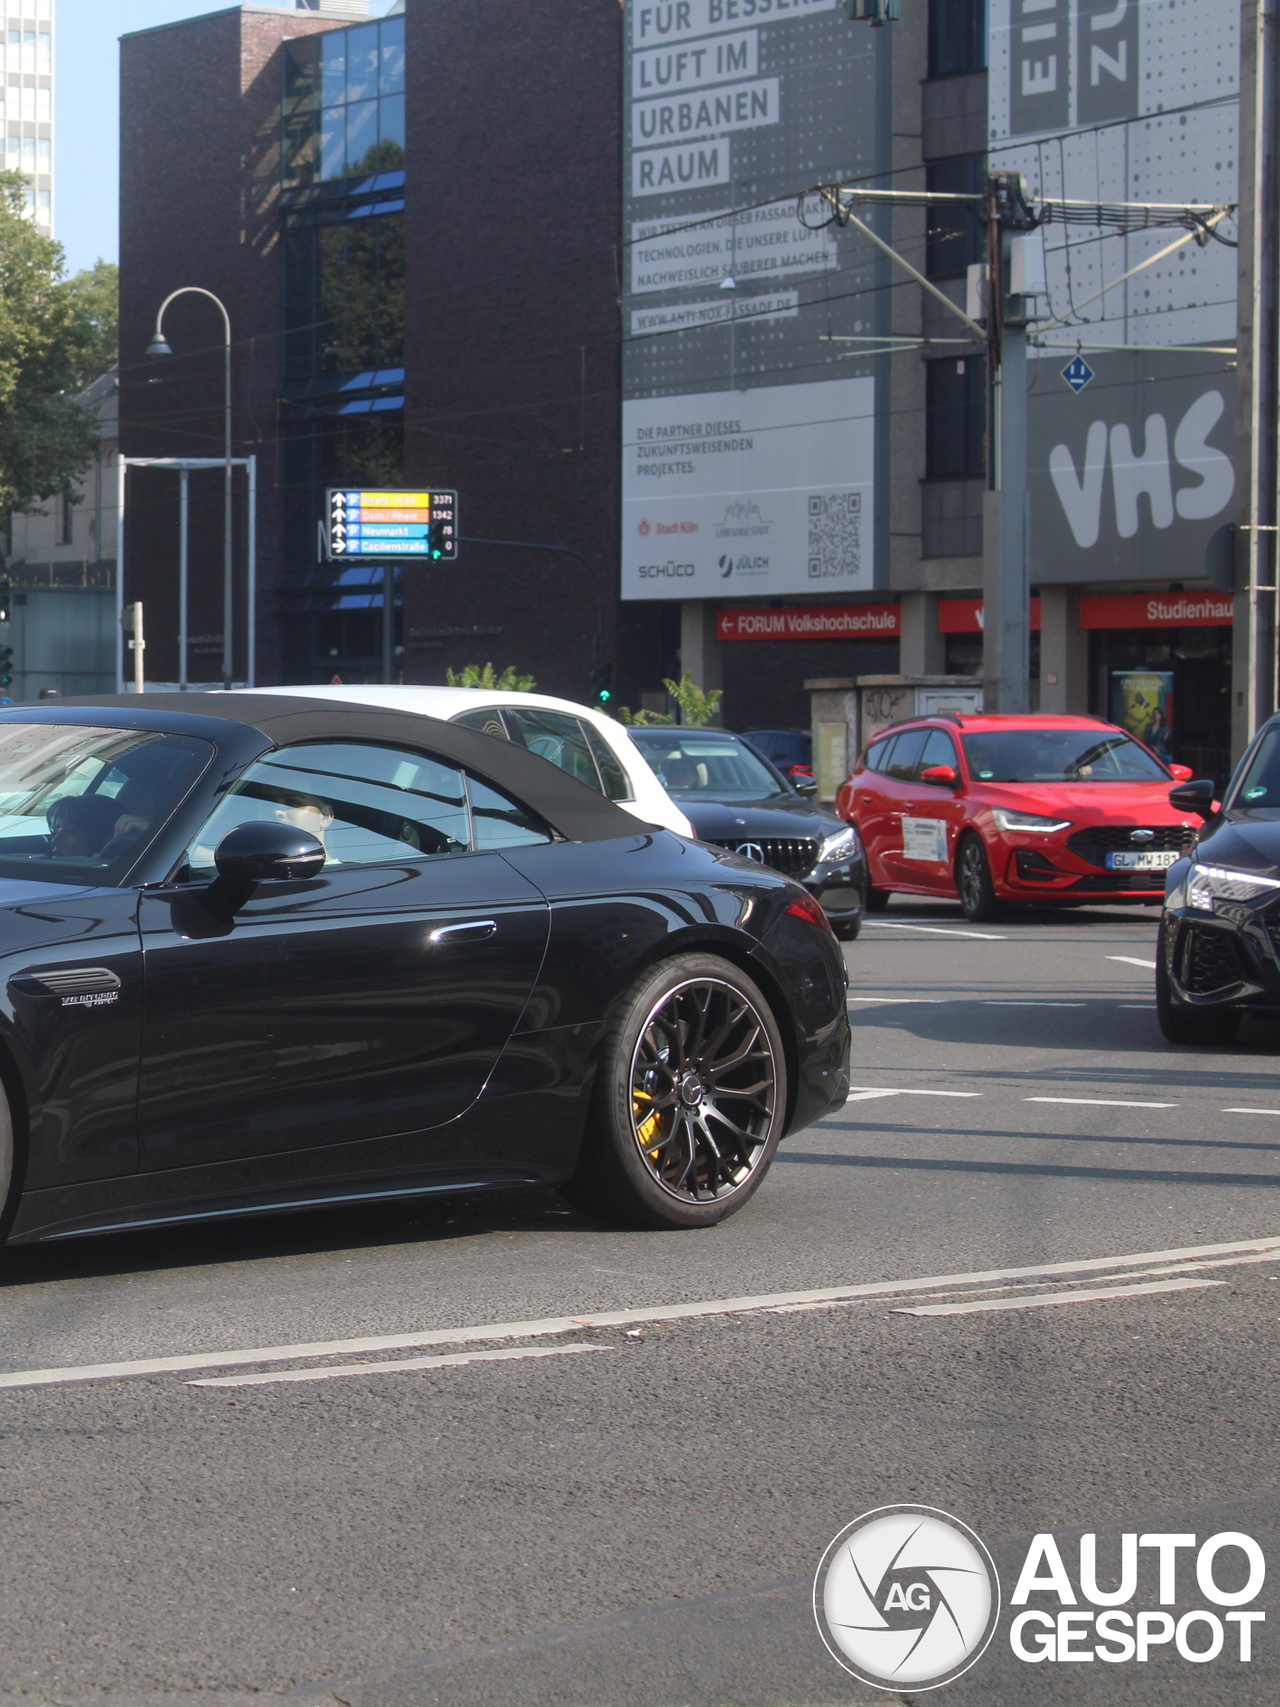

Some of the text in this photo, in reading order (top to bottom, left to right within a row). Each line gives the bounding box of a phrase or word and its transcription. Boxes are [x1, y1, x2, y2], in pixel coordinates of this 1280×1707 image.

[640, 0, 691, 38] FÜR
[640, 40, 747, 89] LUFT IM
[640, 88, 768, 138] URBANEN
[640, 149, 718, 188] RAUM
[638, 225, 658, 239] WIR
[660, 220, 697, 235] TESTEN
[699, 219, 714, 230] AN
[716, 211, 752, 228] DIESER
[755, 203, 803, 222] FASSAD
[638, 228, 820, 263] TECHNOLOGIEN, DIE UNSERE LUFT
[638, 251, 833, 286] NACHWEISLICH SAUBERER MACHEN.
[637, 420, 741, 440] DIE PARTNER DIESES
[637, 438, 754, 458] ZUKUNFTSWEISENDEN
[1049, 389, 1235, 548] VHS
[432, 510, 453, 520] 1342
[363, 526, 408, 536] Neumarkt
[656, 521, 699, 535] Stadt Köln
[751, 525, 770, 536] STADT
[639, 560, 695, 578] SCHÜCO
[736, 554, 769, 570] JÜLICH
[1147, 598, 1233, 619] Studienhau
[738, 611, 896, 633] FORUM Volkshochschule
[1113, 854, 1130, 866] GL
[1137, 854, 1153, 866] MW
